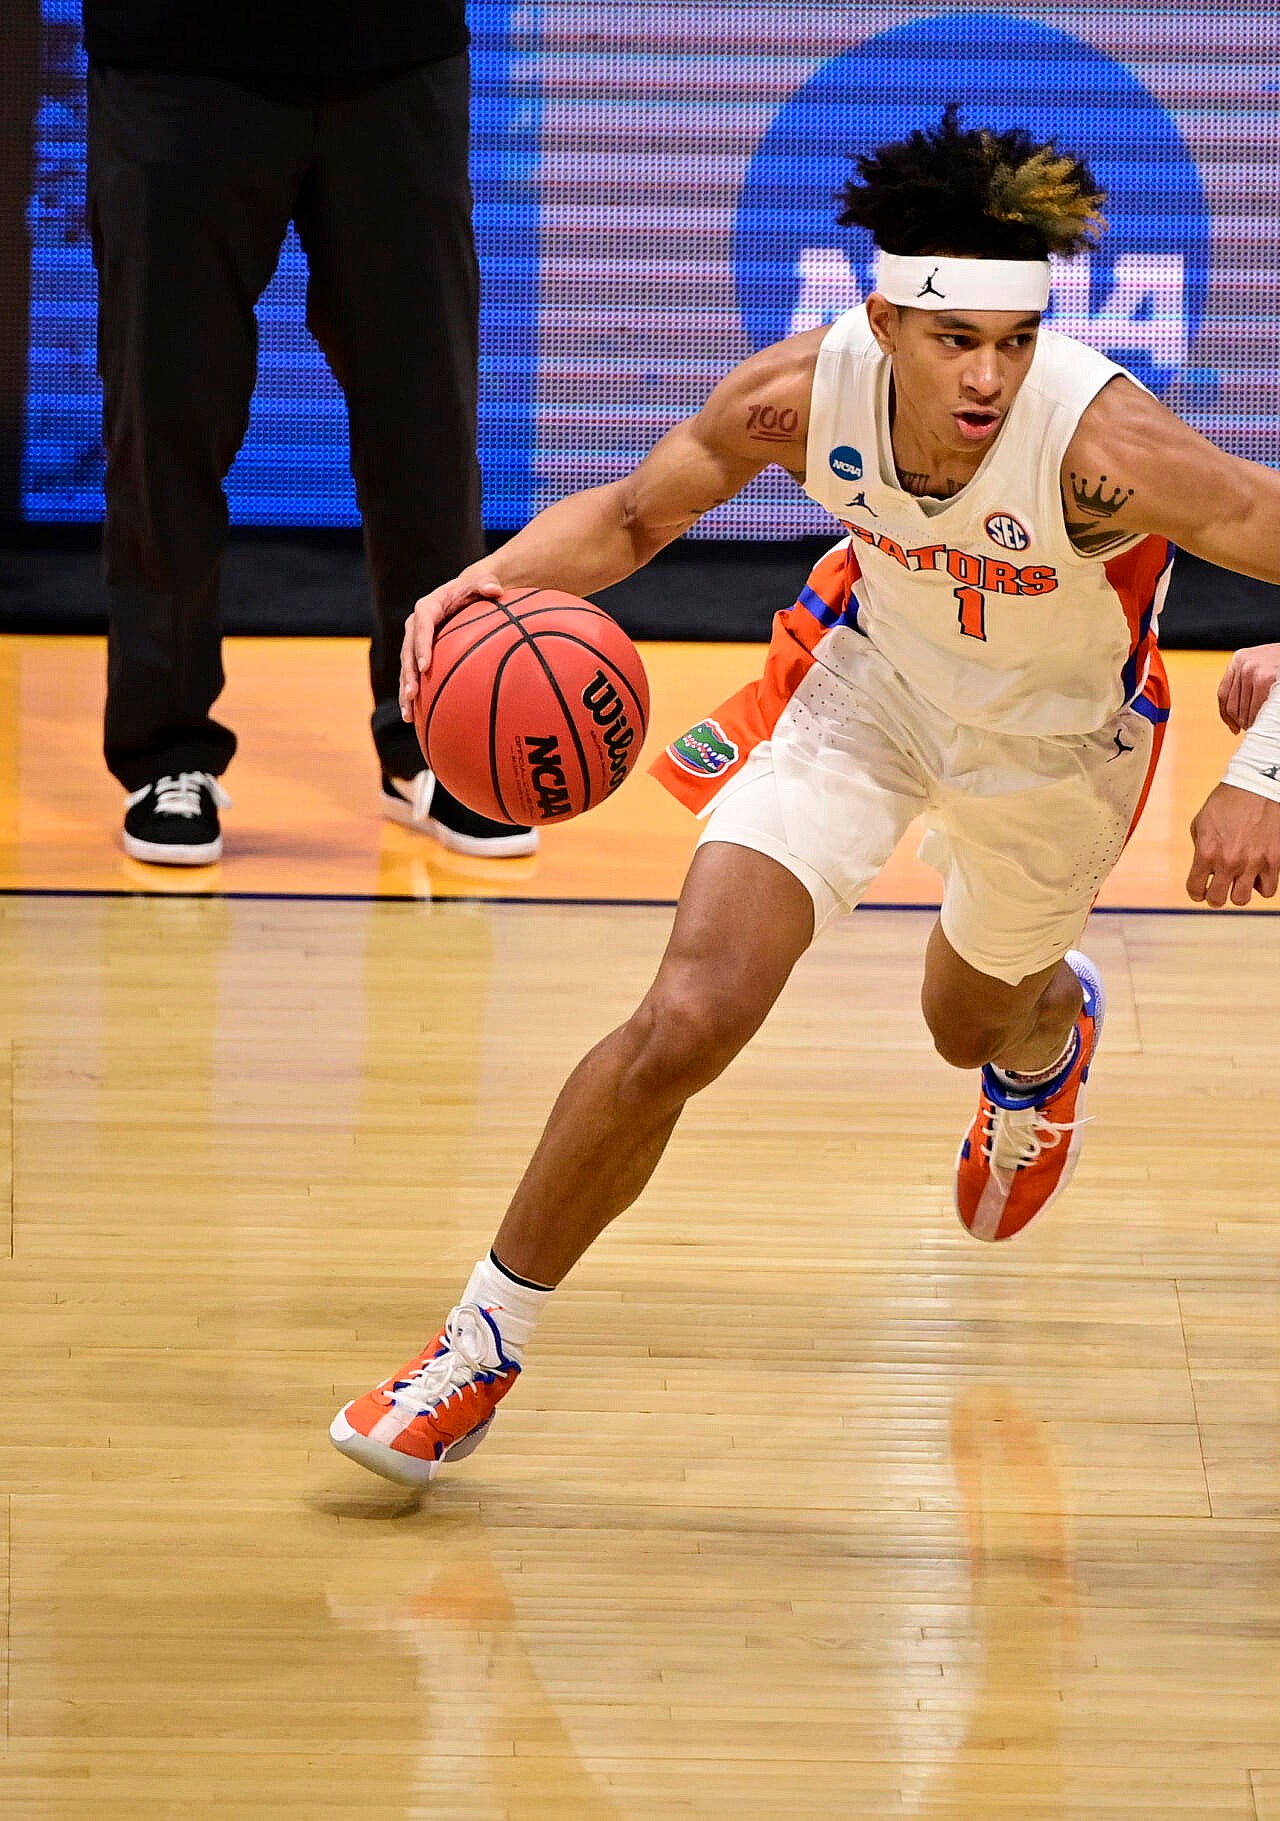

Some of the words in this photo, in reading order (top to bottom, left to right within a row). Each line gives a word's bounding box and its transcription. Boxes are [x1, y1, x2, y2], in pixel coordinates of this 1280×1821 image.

[746, 404, 799, 432] 100
[831, 458, 863, 478] NCAA
[838, 518, 1059, 597] GATORS
[986, 515, 1029, 550] SEC
[953, 586, 987, 643] 1
[581, 668, 635, 789] Wilso
[524, 735, 572, 819] NCAA
